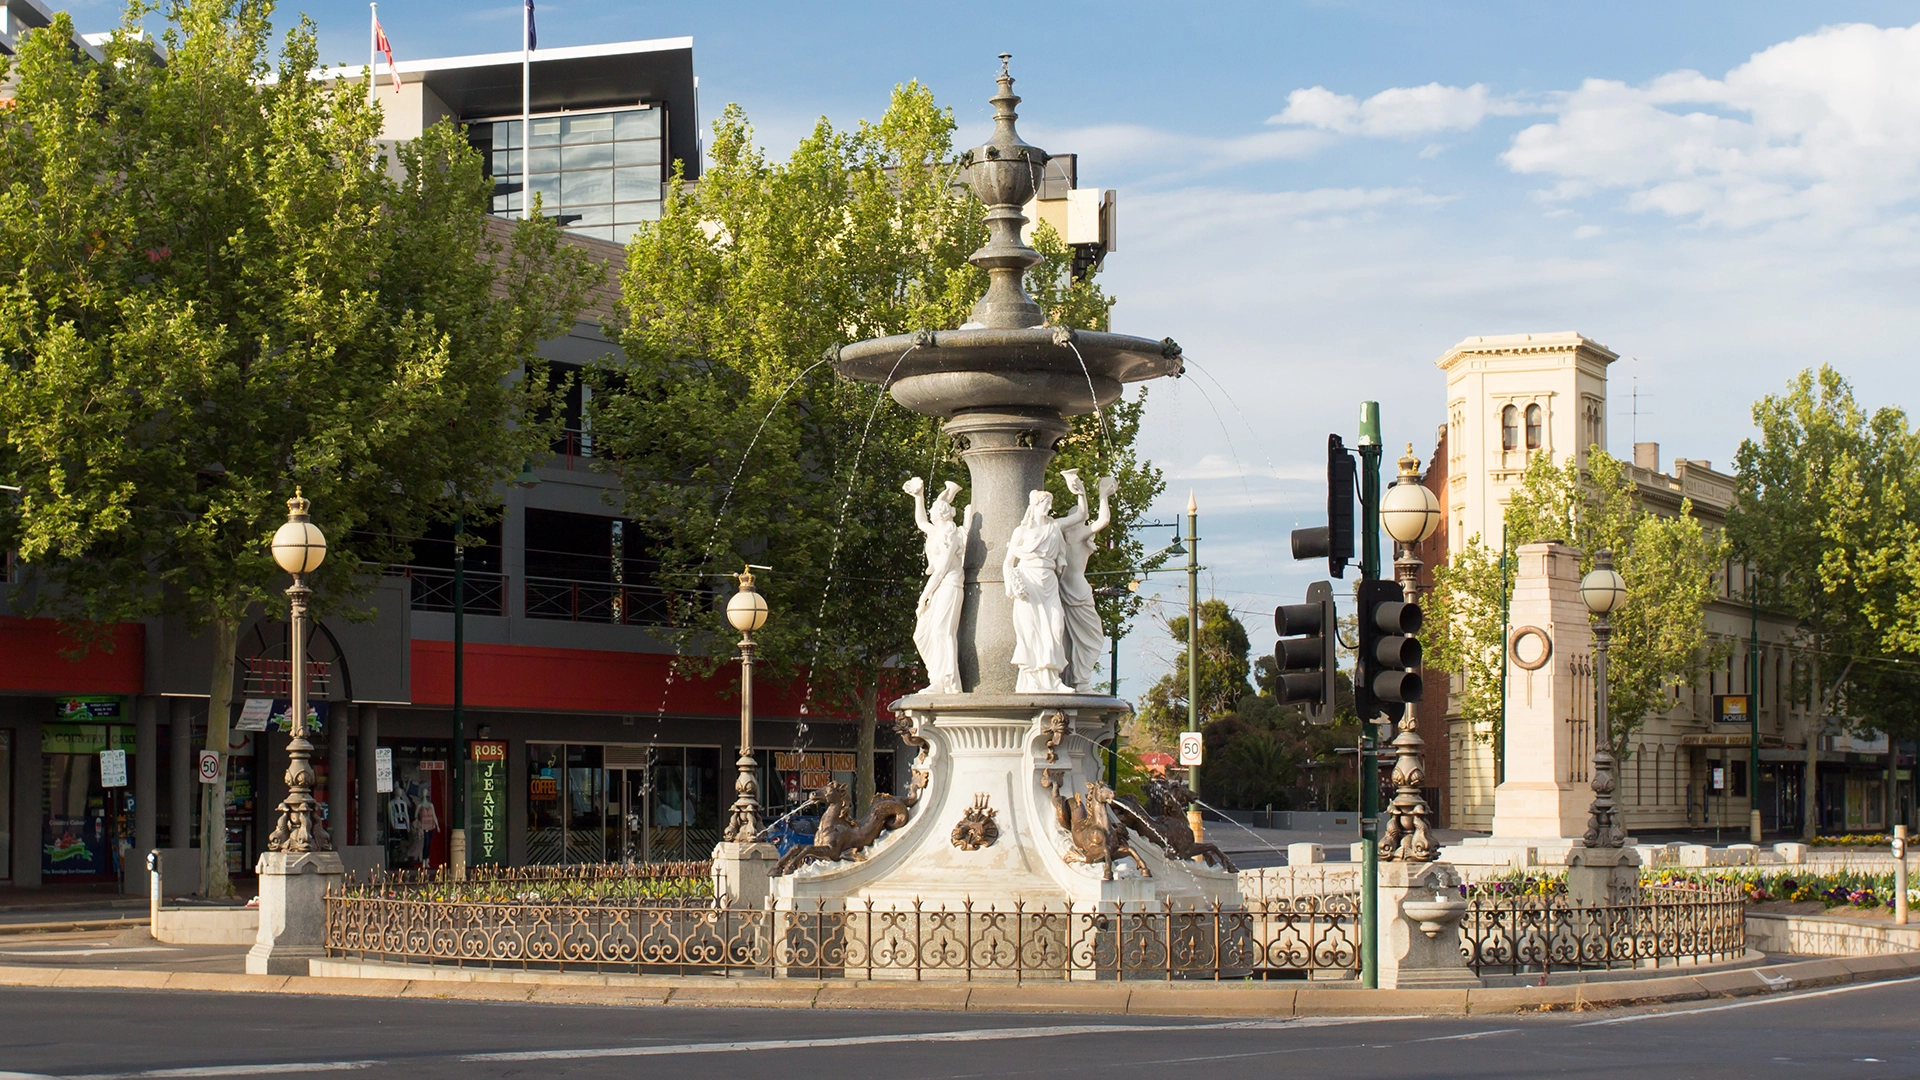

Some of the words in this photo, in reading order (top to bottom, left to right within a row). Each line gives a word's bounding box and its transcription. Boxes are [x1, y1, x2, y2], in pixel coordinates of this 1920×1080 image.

[55, 733, 106, 744] COUNTRY
[111, 734, 136, 744] CAKE
[475, 745, 503, 756] ROBS
[1184, 743, 1198, 754] 50
[203, 761, 216, 773] 50
[775, 753, 824, 771] TRADIIONAL
[801, 771, 830, 790] CUISINE
[530, 780, 557, 795] COFFEE
[483, 762, 495, 858] JEANERY
